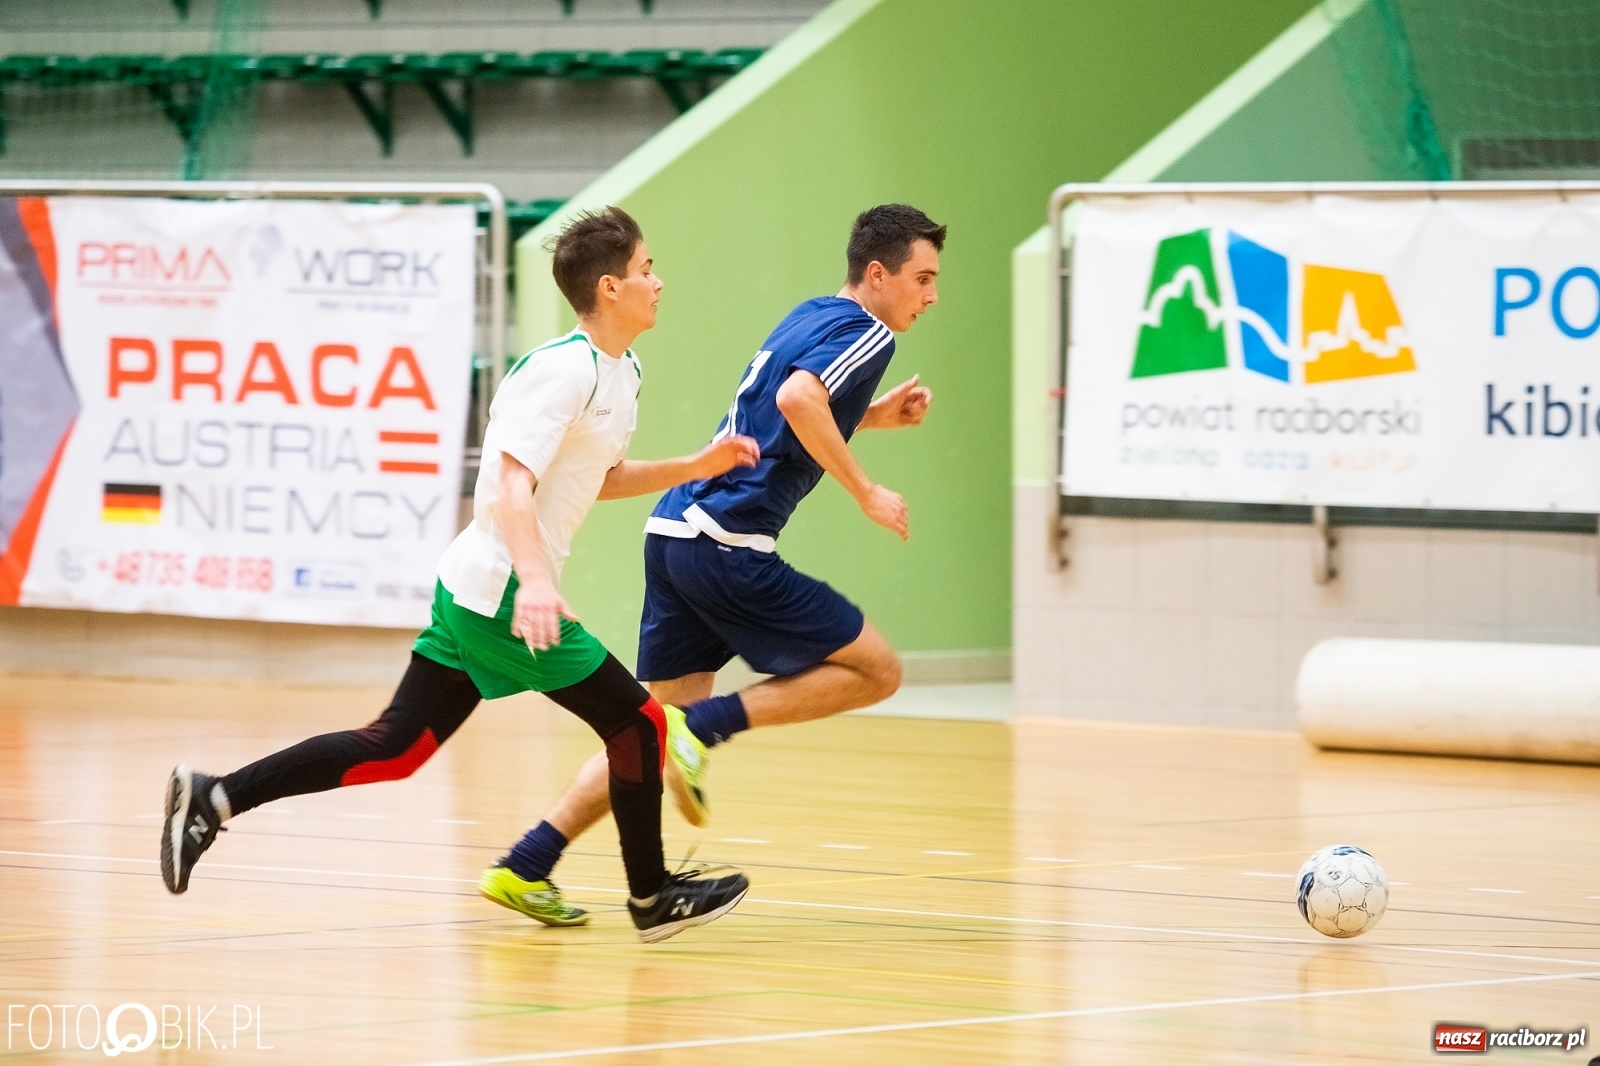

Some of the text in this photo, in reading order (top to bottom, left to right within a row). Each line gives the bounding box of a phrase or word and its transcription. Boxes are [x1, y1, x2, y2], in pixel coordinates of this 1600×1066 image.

[76, 241, 443, 287] PRIMA WORK
[1493, 265, 1600, 340] PO
[107, 336, 437, 411] PRACA
[1121, 396, 1236, 437] powiat
[1484, 383, 1600, 438] kibi
[104, 417, 366, 475] AUSTRIA
[174, 483, 442, 541] NIEMCY
